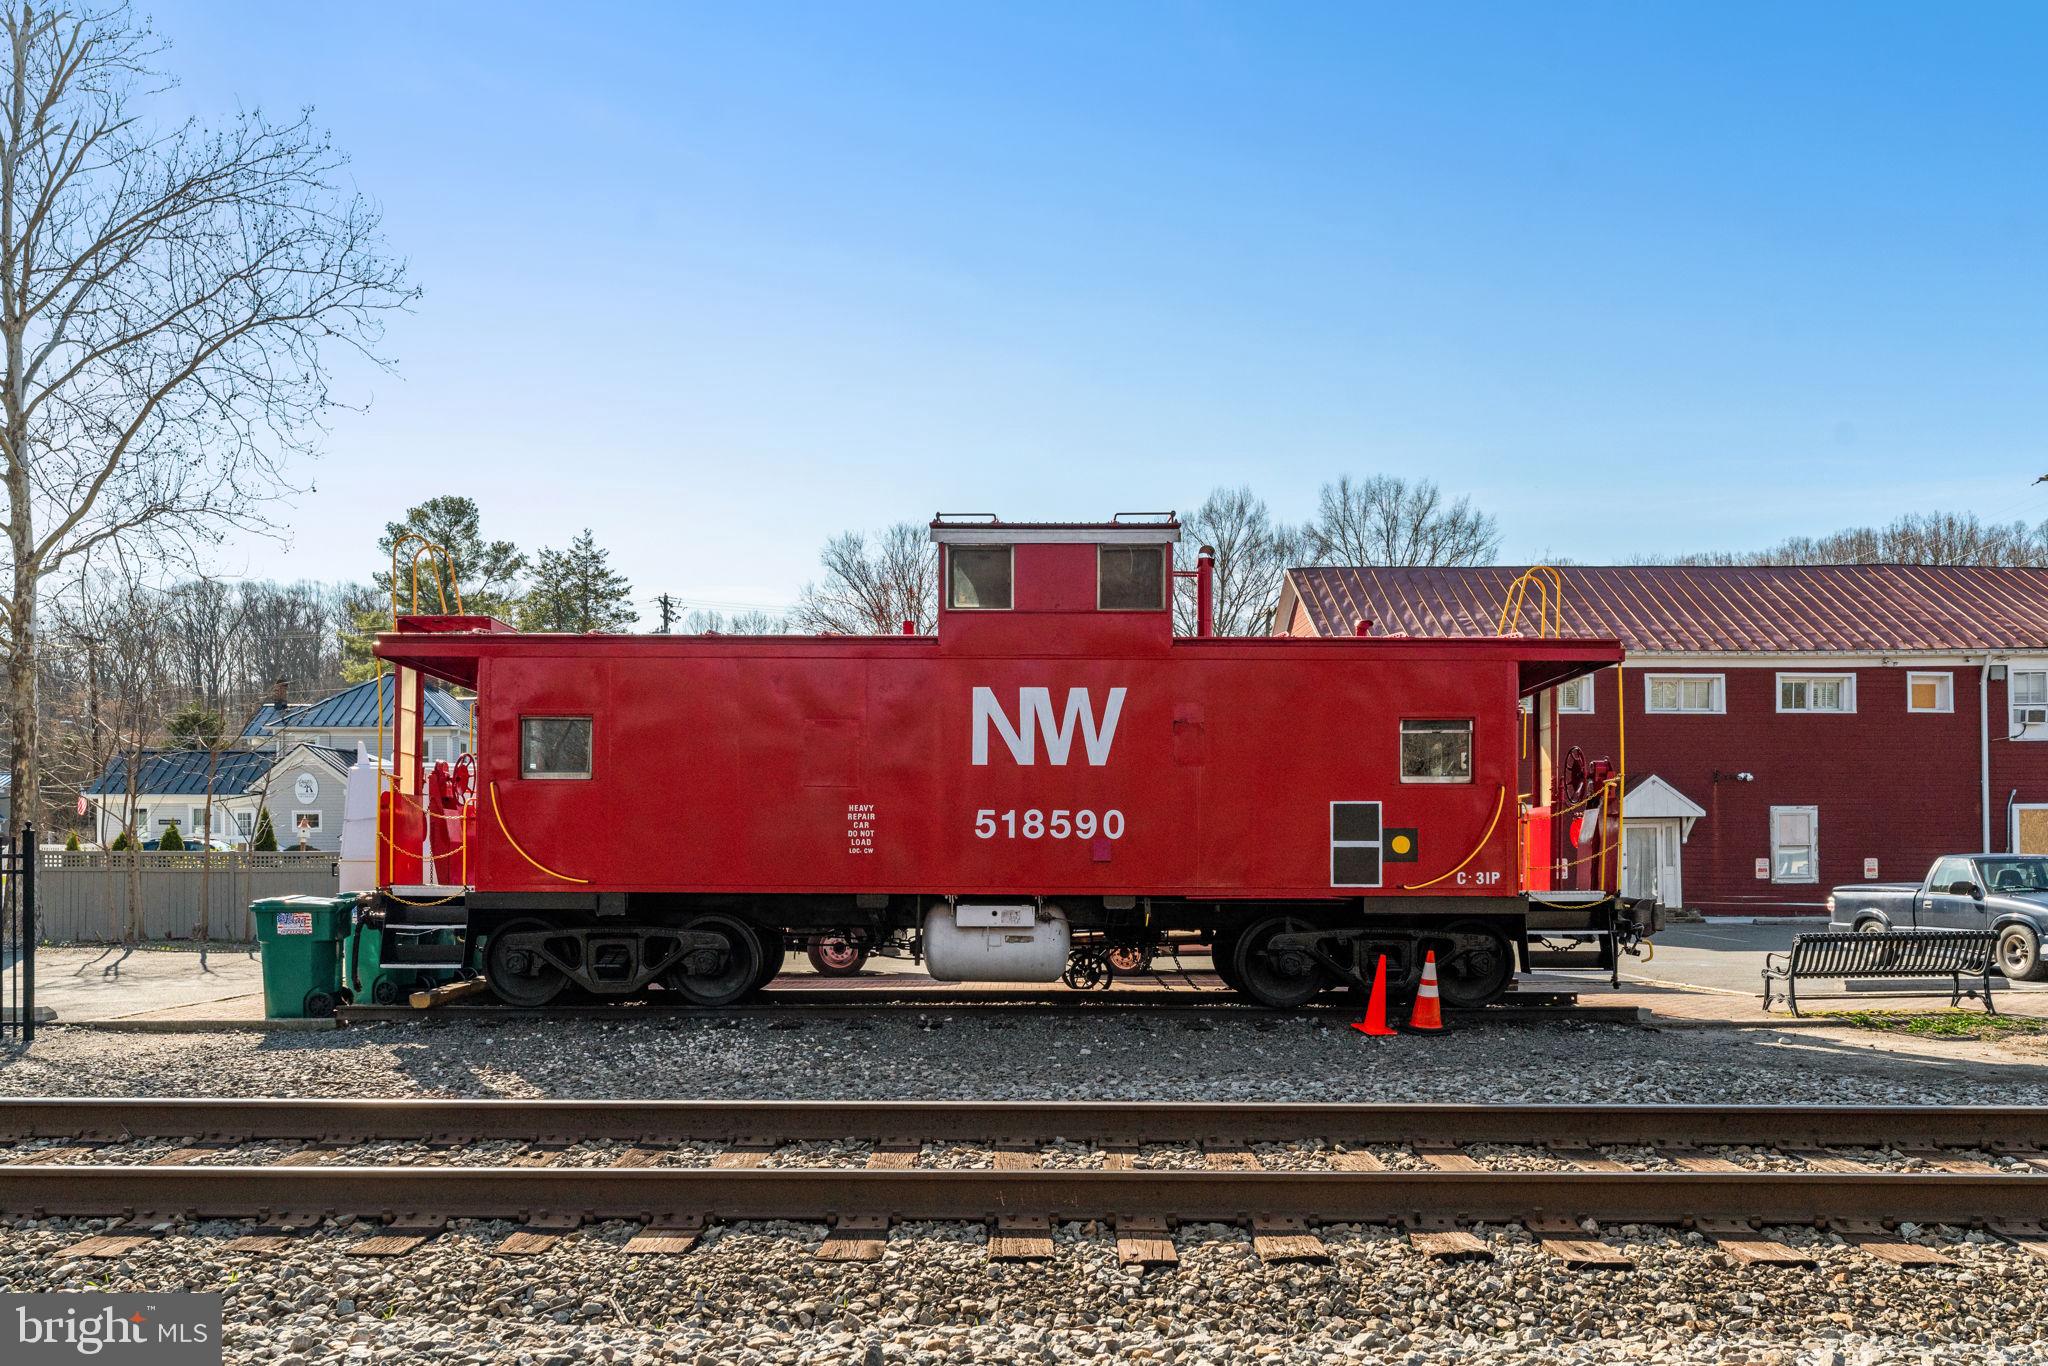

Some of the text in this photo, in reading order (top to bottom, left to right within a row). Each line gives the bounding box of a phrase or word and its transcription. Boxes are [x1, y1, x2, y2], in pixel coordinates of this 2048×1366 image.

[972, 686, 1128, 766] NW
[848, 804, 874, 812] HEAVY
[847, 813, 876, 821] REPAIR
[853, 821, 870, 829] CAR
[975, 809, 1125, 839] 518590
[847, 830, 875, 838] DO NOT
[851, 838, 872, 846] LOAD
